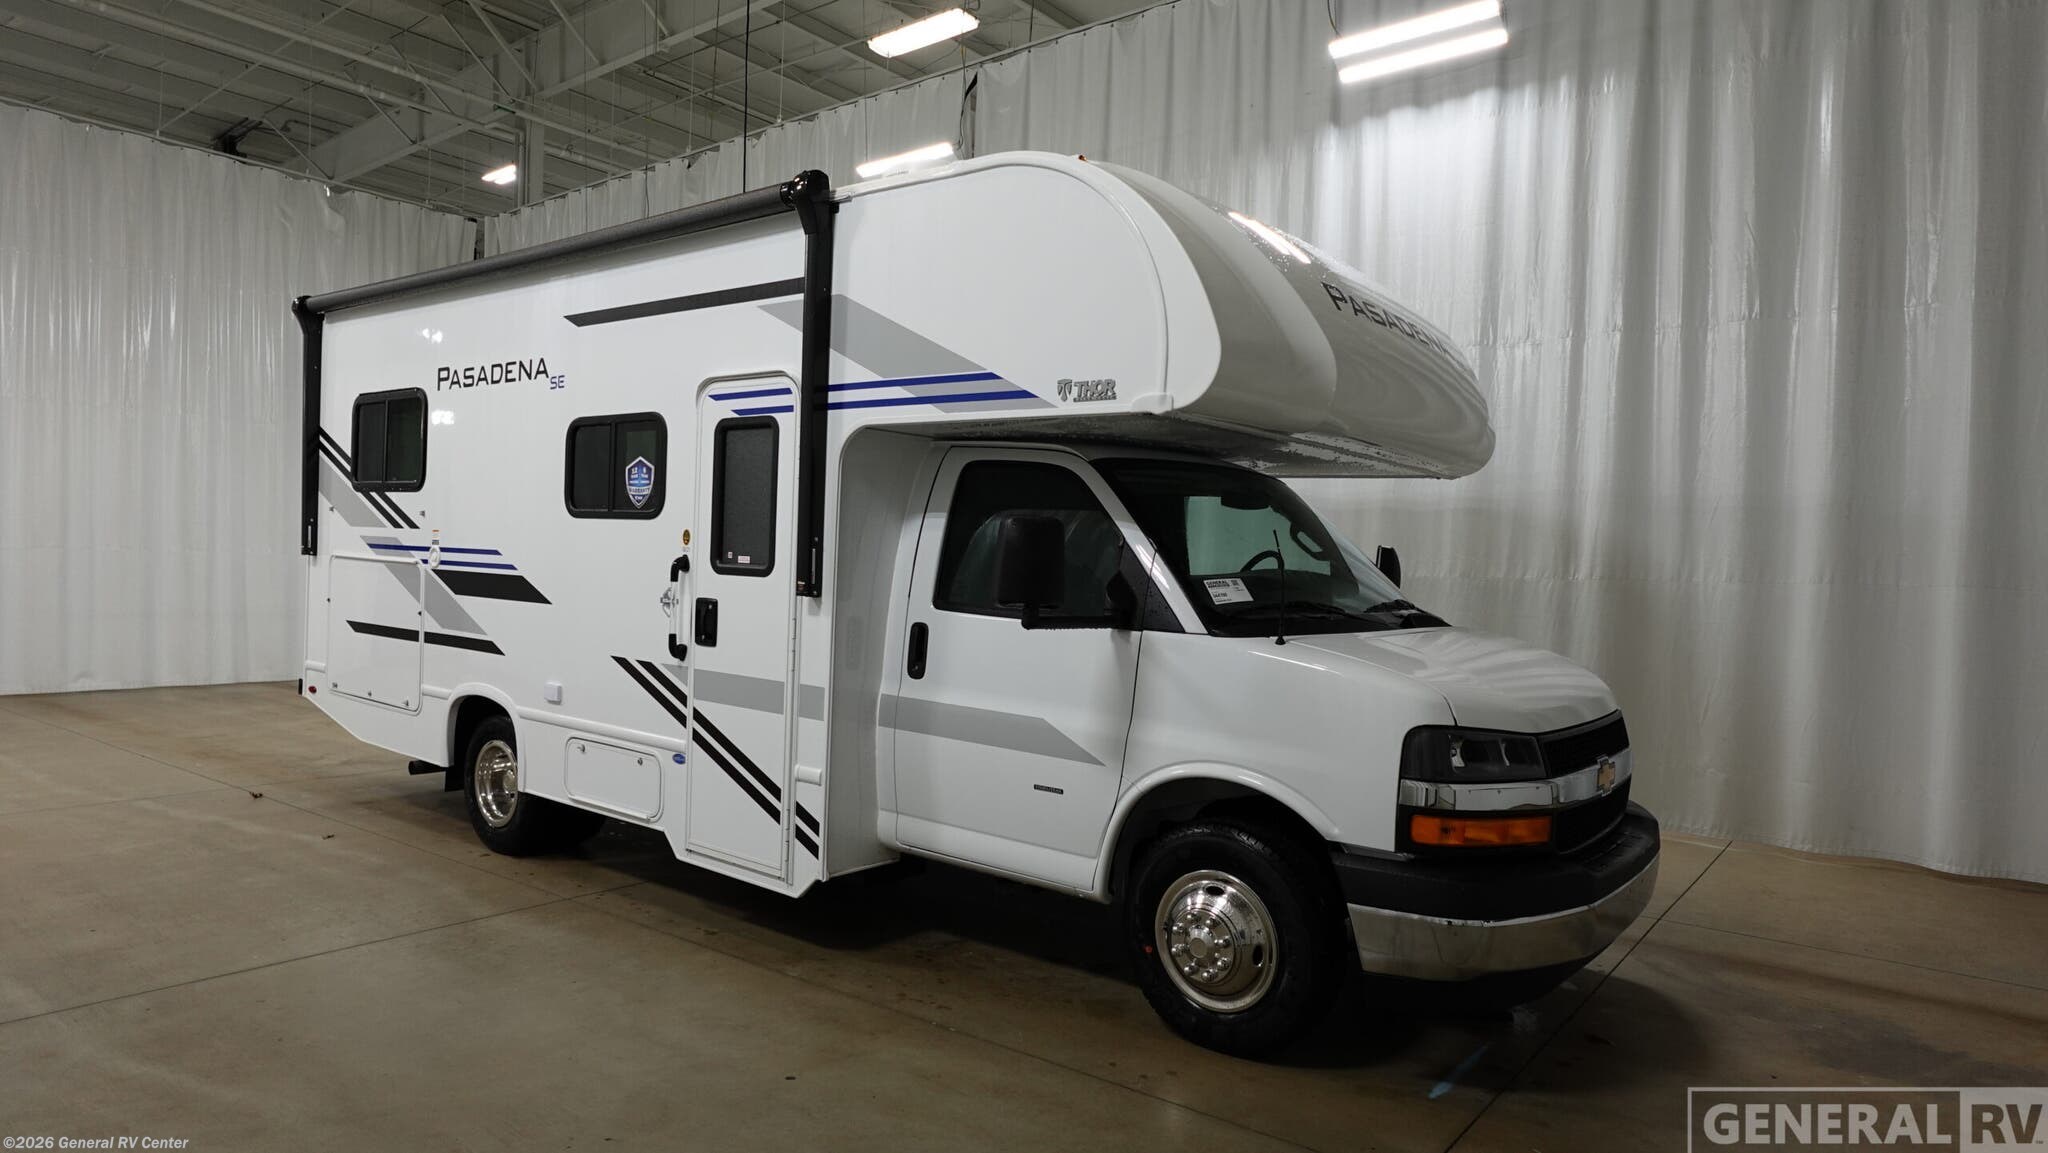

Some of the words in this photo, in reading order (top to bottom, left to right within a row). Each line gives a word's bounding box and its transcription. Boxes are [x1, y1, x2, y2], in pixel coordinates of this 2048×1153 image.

[1321, 281, 1457, 361] PASADEN
[437, 357, 549, 391] PASADENA
[550, 375, 565, 390] SE
[1073, 379, 1117, 398] THOR
